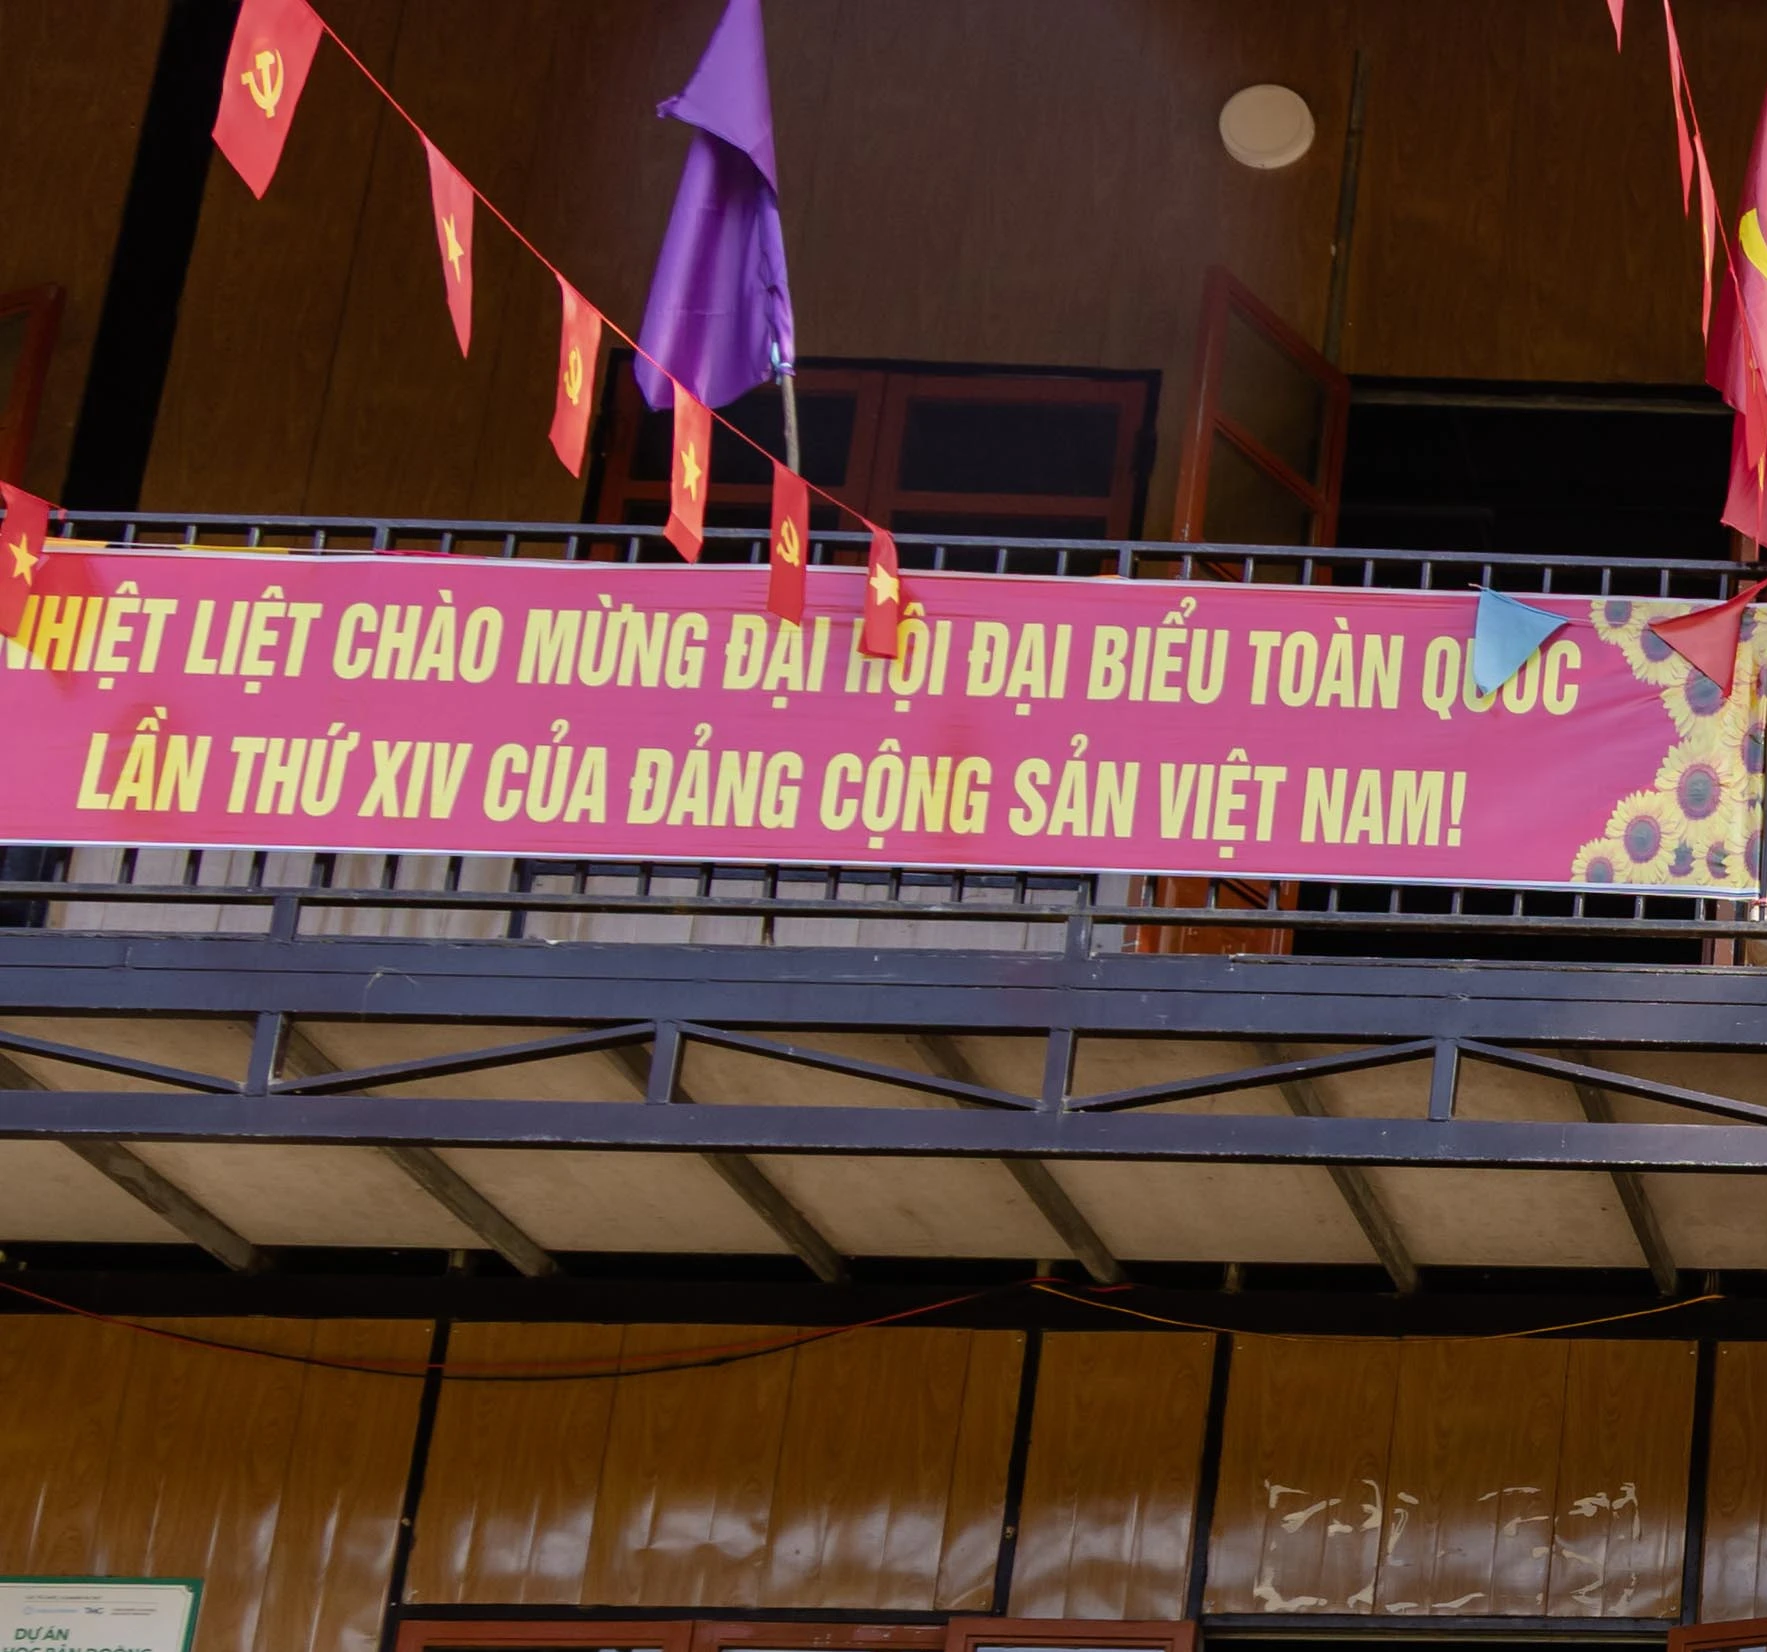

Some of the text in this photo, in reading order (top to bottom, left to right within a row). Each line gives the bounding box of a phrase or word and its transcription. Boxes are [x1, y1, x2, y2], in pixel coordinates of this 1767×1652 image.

[184, 586, 322, 694] LIỆT
[332, 590, 501, 681] CHÀO
[517, 594, 706, 690] MỪNG
[723, 614, 830, 709] ĐẠI
[966, 620, 1067, 716] ĐẠI
[1087, 596, 1230, 704] BIỂU
[1249, 617, 1404, 710] TOÀN
[76, 706, 1467, 860] LẦN THỨ XIV CỦA ĐẢNG CỘNG SẢN VIỆT NAM!
[15, 1626, 70, 1643] DỰ ÁN
